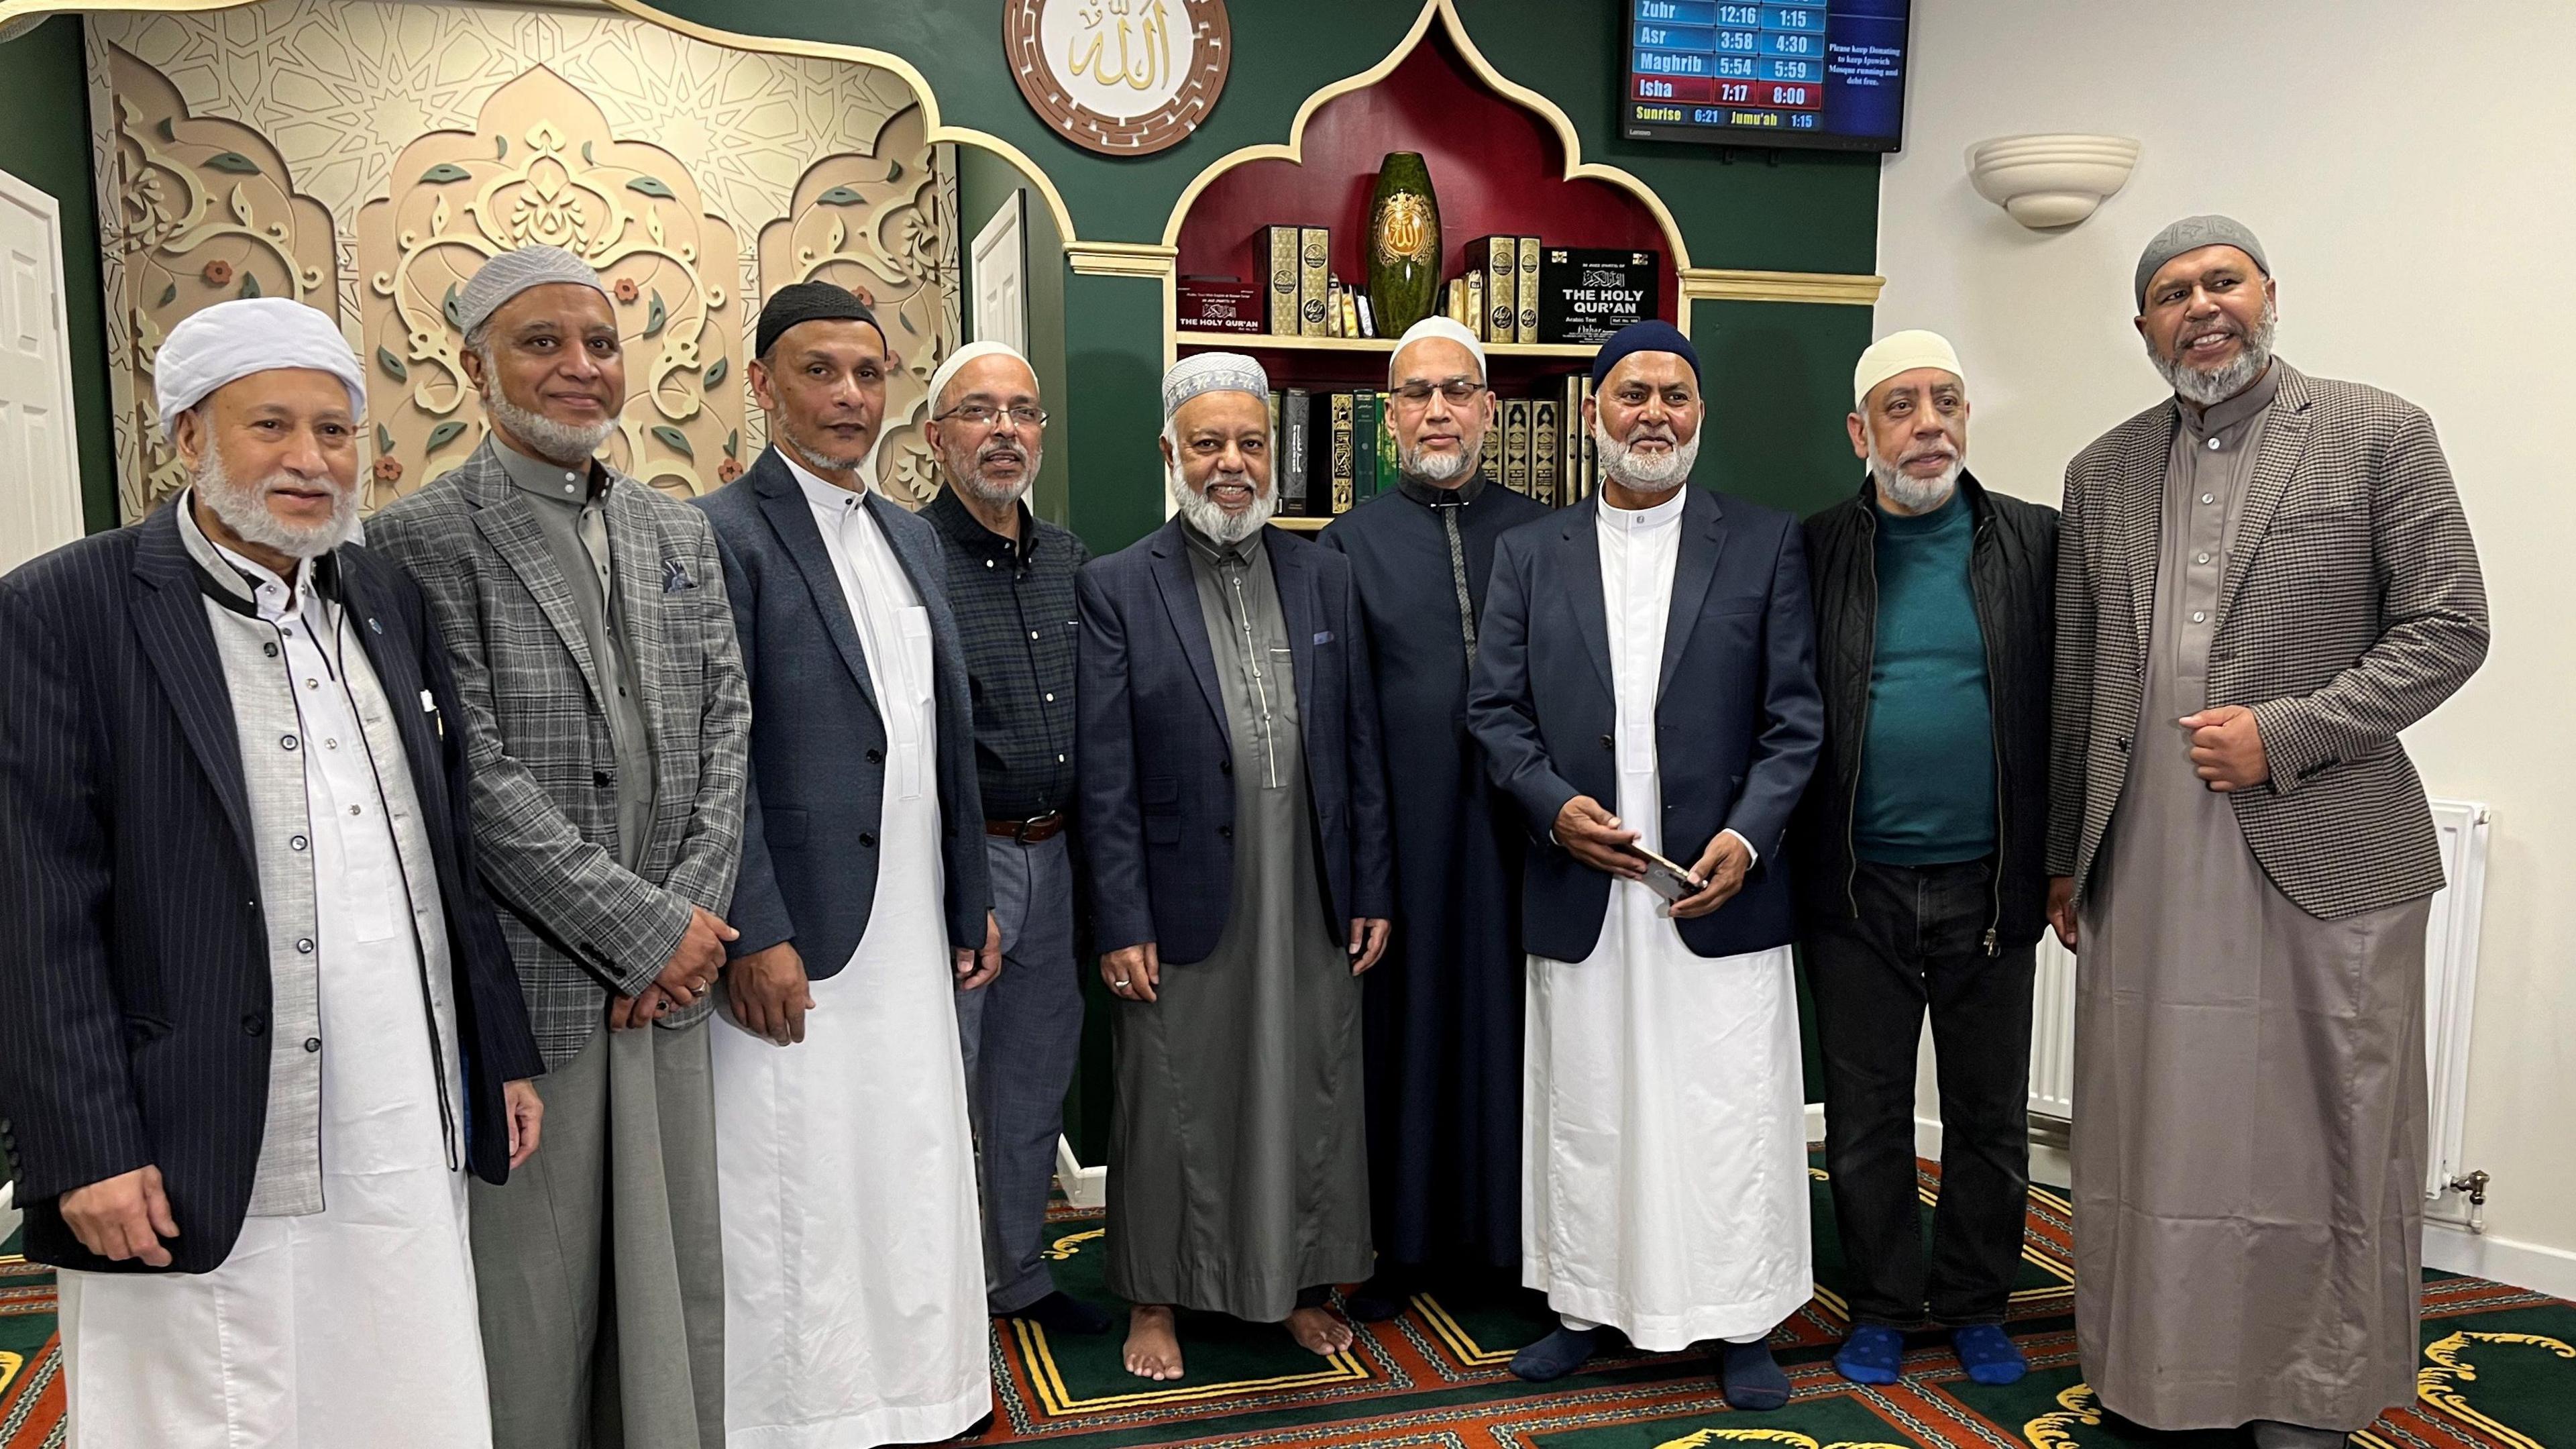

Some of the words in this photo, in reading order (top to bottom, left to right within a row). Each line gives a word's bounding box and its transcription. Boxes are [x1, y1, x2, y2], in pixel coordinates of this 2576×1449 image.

[1642, 0, 1676, 19] Zuhr
[1720, 5, 1756, 24] 12:16
[1780, 9, 1807, 27] 1:15
[1641, 27, 1666, 44] Asr
[1721, 32, 1753, 50] 3:58
[1776, 35, 1807, 53] 4:30
[1829, 44, 1850, 52] Please
[1851, 45, 1868, 55] keep
[1870, 46, 1900, 56] Donating
[1641, 52, 1702, 72] Maghrib
[1720, 58, 1752, 75] 5:54
[1775, 61, 1807, 78] 5:59
[1846, 55, 1863, 65] keep
[1864, 56, 1890, 66] Ipswich
[1829, 64, 1856, 75] Mosque
[1640, 79, 1672, 97] Isha
[1722, 84, 1748, 101] 7:17
[1773, 87, 1805, 105] 8:00
[1636, 106, 1681, 121] Sunrise
[1695, 109, 1717, 123] 6:21
[1731, 111, 1777, 126] Jumu'ah
[1792, 115, 1813, 127] 1:15
[1562, 289, 1595, 301] THE
[1601, 290, 1644, 301] HOLY
[1574, 302, 1636, 313] QUR'AN
